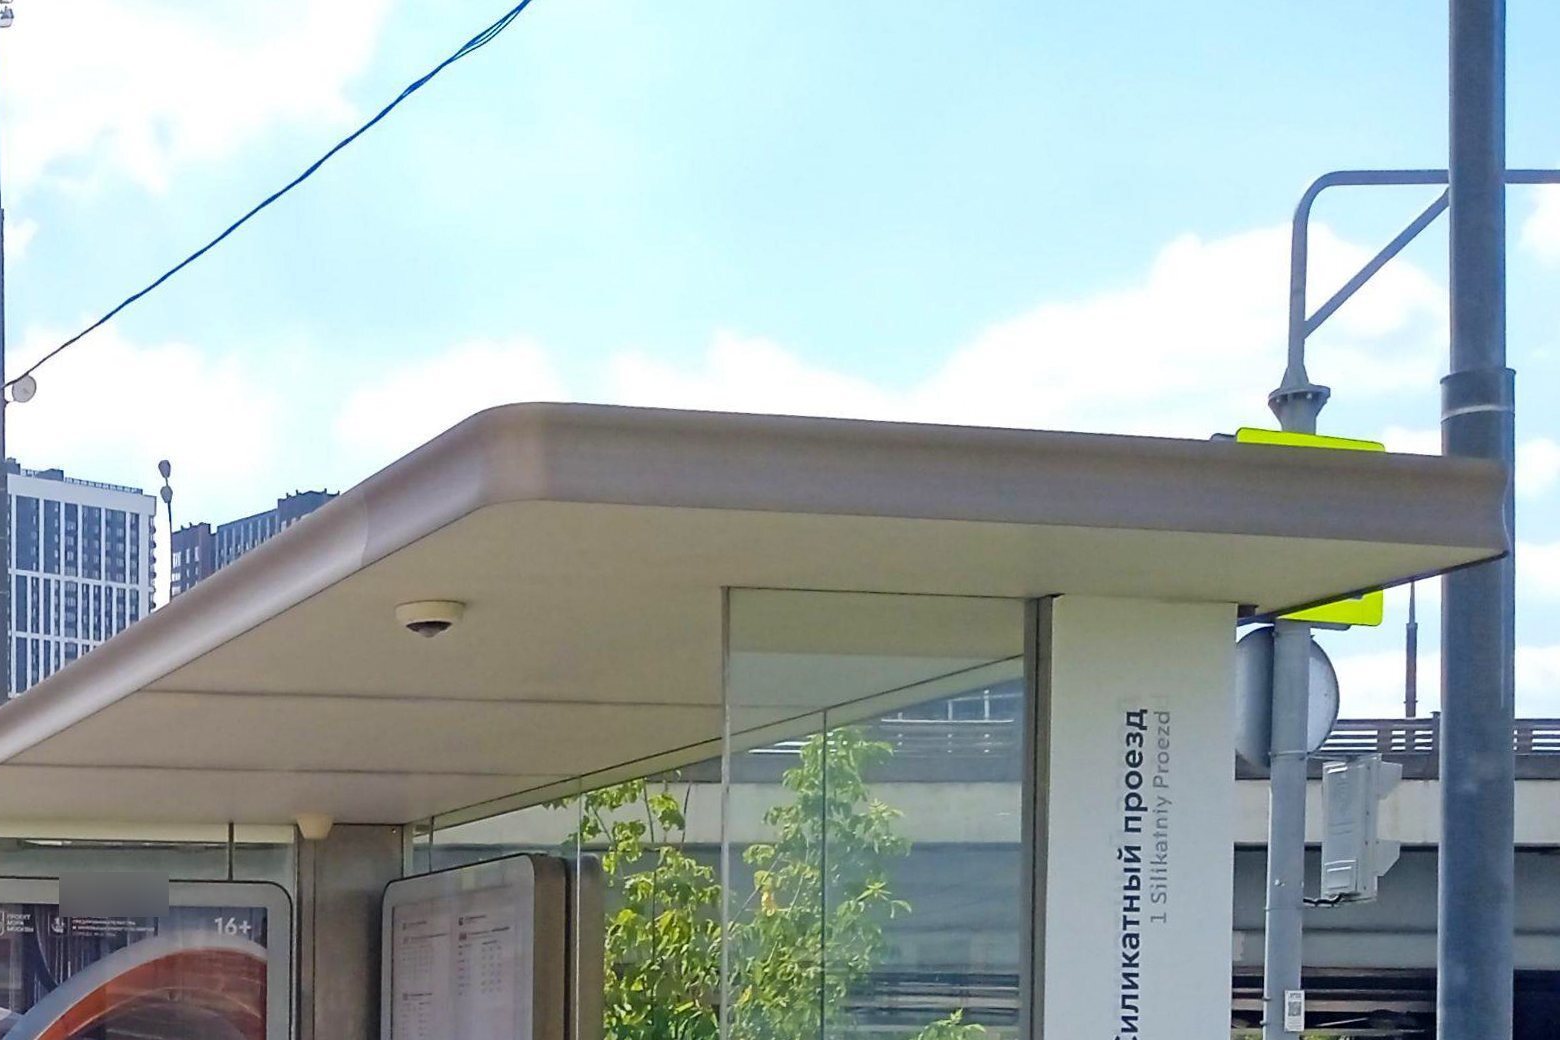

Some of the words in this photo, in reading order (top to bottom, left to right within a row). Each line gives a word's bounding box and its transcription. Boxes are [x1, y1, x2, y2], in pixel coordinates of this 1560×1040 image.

[1123, 709, 1148, 833] проезд
[1153, 711, 1171, 789] Proezd
[1150, 796, 1173, 905] Silikatniy
[214, 916, 251, 936] 16+
[1150, 912, 1167, 924] 1
